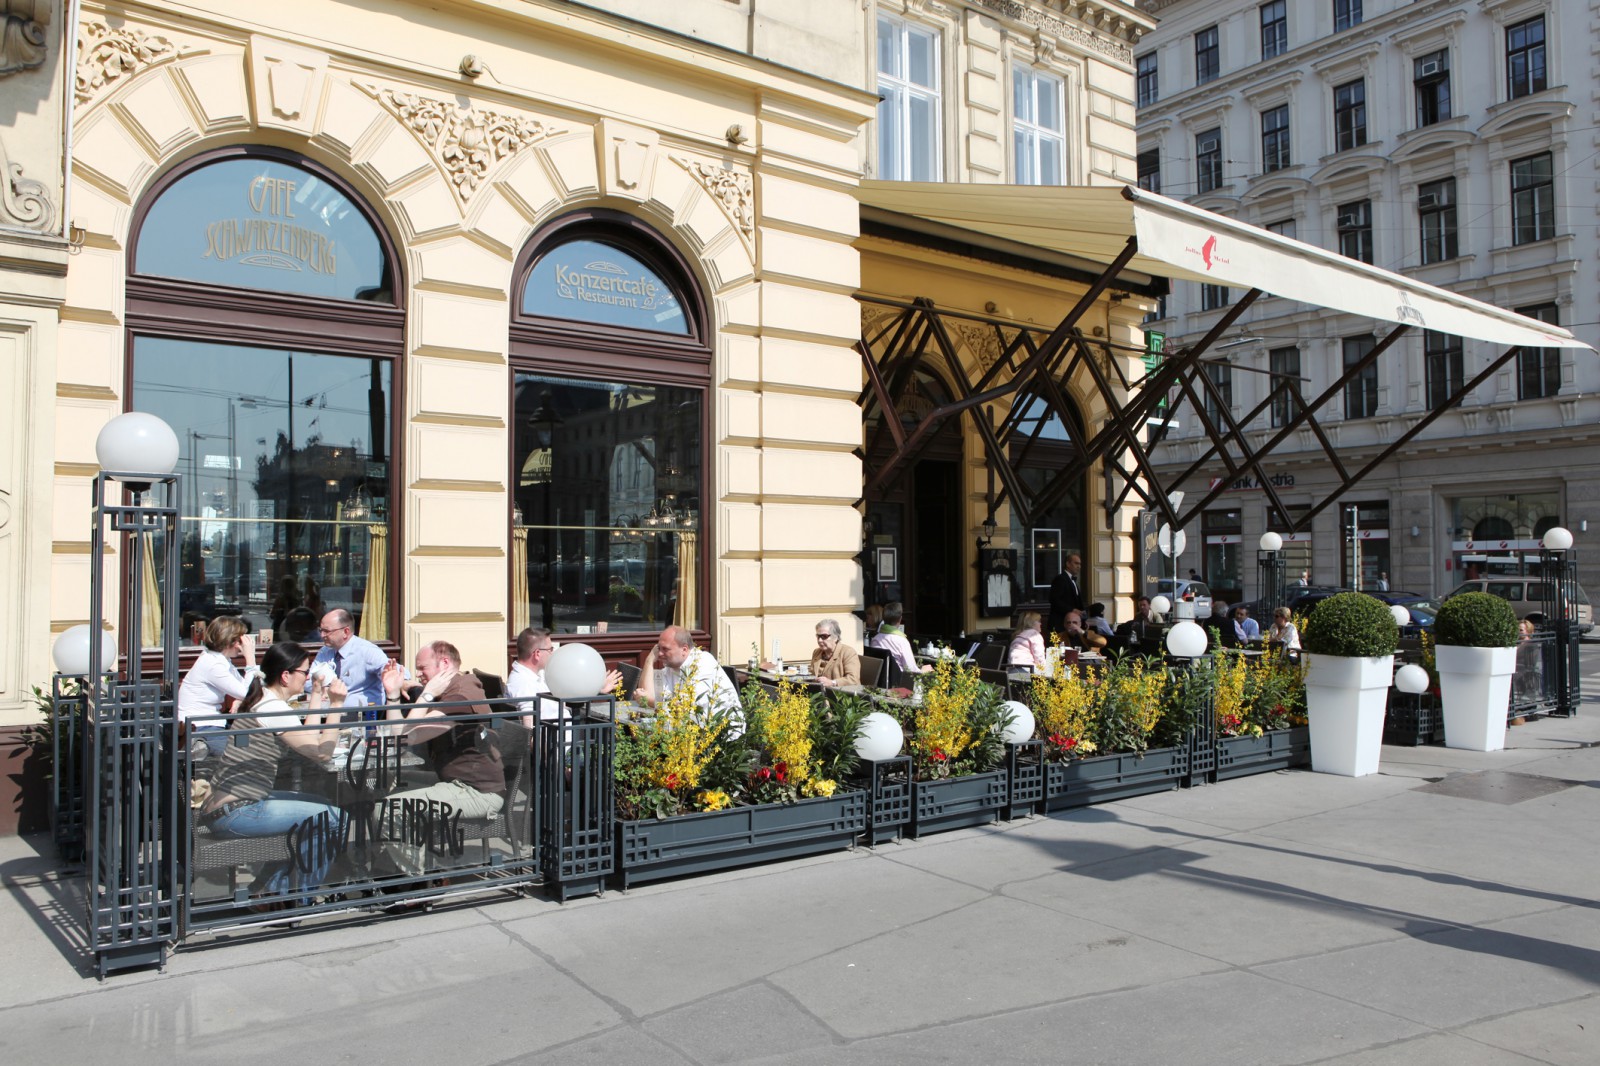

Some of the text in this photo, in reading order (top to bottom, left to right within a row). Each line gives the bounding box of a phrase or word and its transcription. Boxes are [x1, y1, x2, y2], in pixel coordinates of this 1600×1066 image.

[204, 218, 336, 275] SCHWARZENBERG
[556, 264, 655, 297] Konzertcafé
[577, 286, 637, 308] Restaurant
[1223, 476, 1252, 489] ank
[346, 735, 409, 791] CAFE
